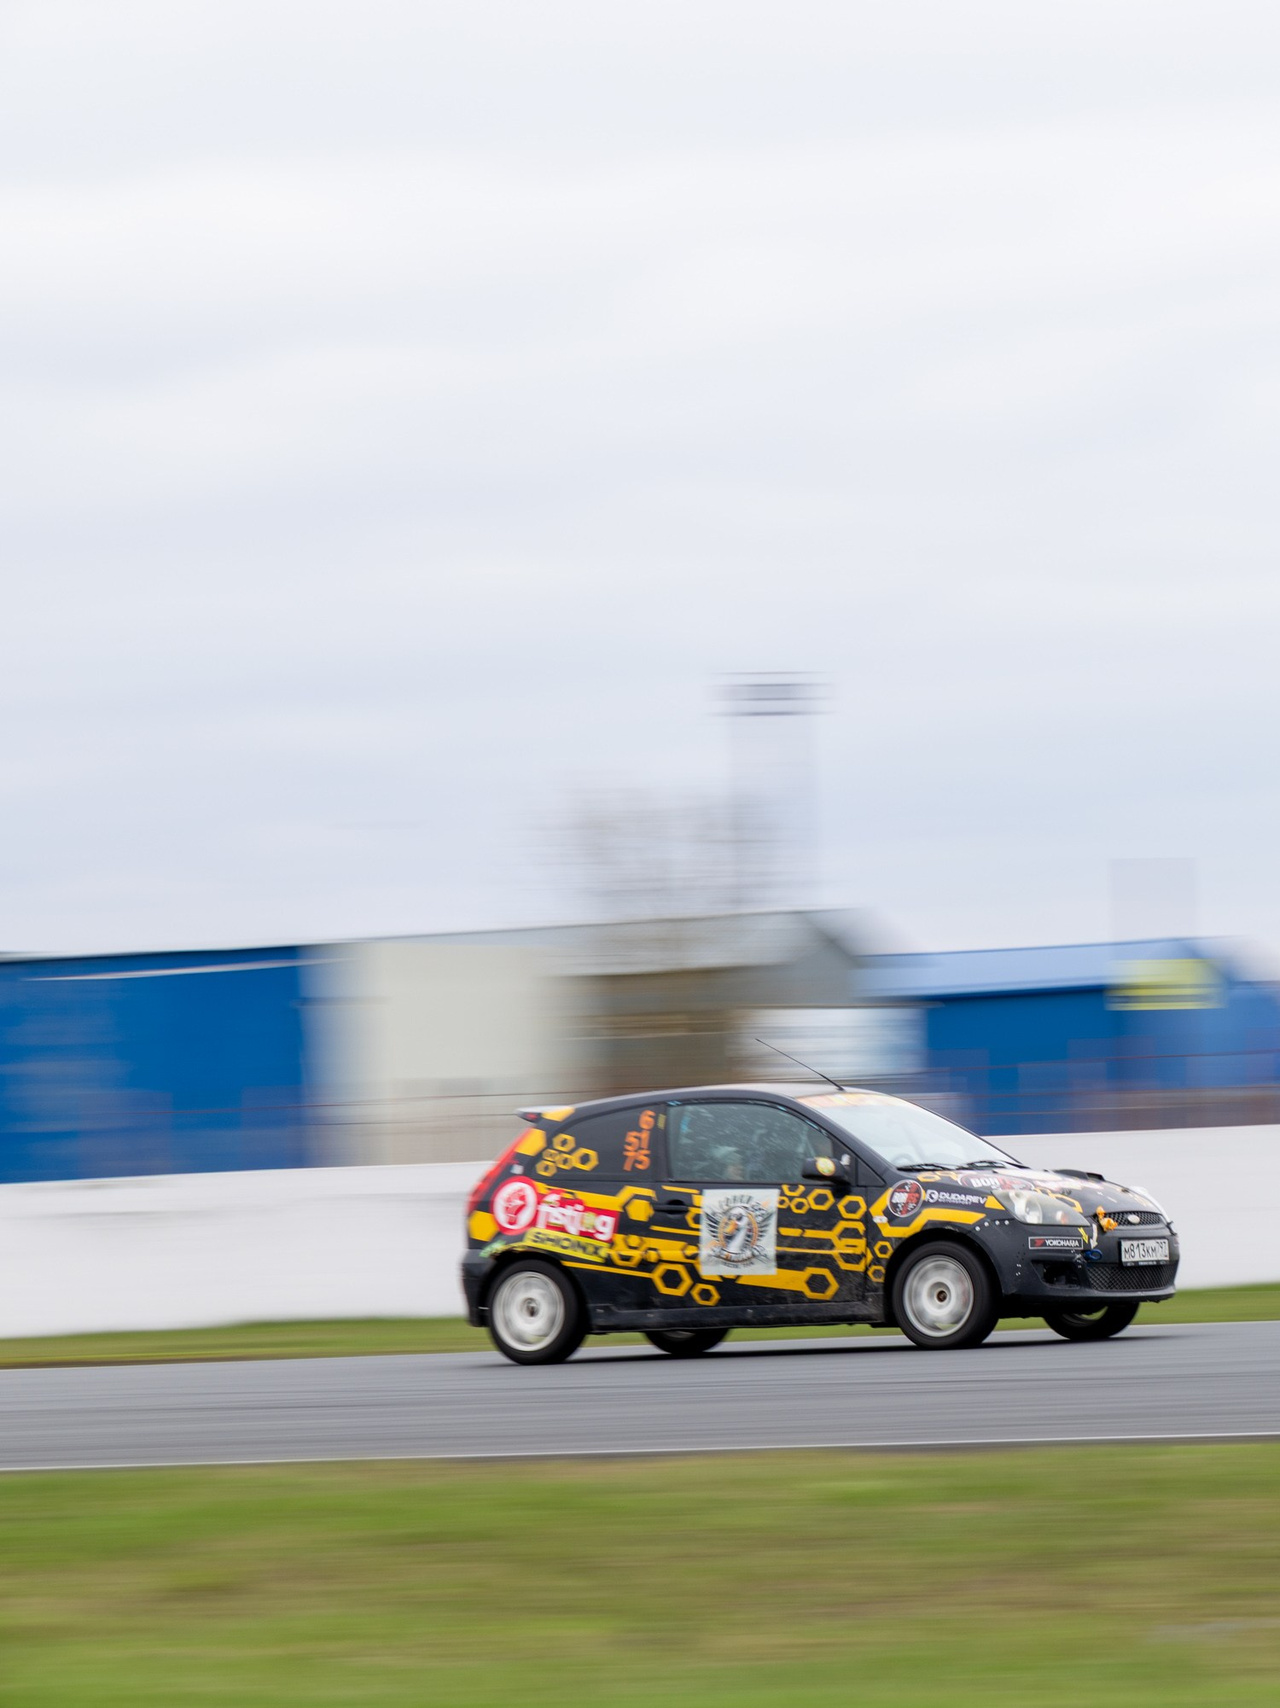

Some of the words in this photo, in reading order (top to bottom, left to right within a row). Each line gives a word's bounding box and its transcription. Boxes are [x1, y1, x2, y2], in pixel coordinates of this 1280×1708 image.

[638, 1109, 656, 1130] 6
[624, 1130, 650, 1151] 51
[622, 1149, 651, 1172] 75
[939, 1191, 987, 1204] DUDAREV
[1043, 1239, 1079, 1248] YOKOHAMA
